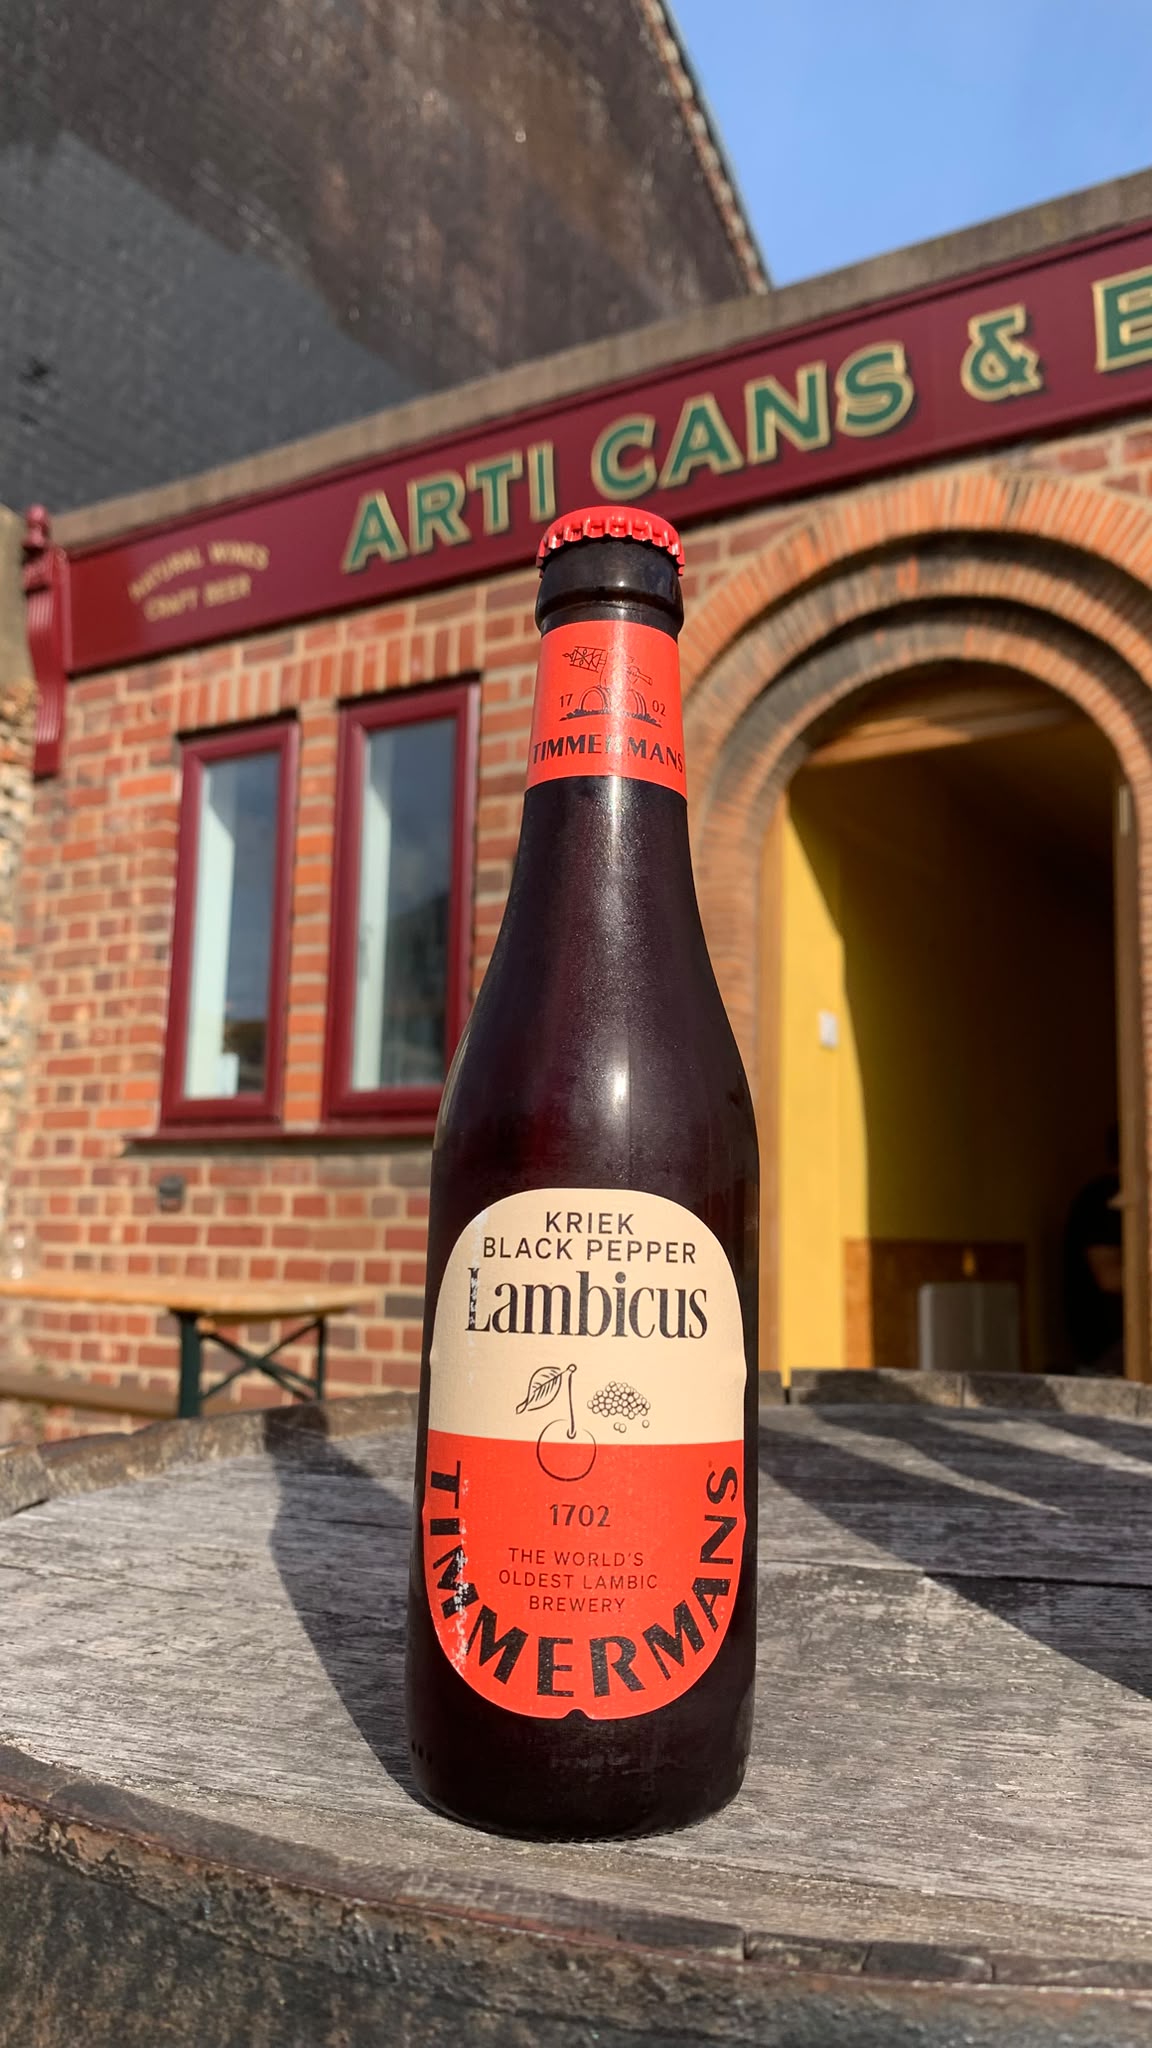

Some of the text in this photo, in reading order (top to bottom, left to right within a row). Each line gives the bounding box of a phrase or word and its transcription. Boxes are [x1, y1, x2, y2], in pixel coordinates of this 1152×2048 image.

[343, 442, 556, 572] ARTI
[590, 341, 916, 501] CANS
[961, 304, 1042, 400] &
[533, 734, 683, 773] TIMMEMANS
[545, 1211, 635, 1235] KRIEK
[483, 1237, 696, 1265] BLACK PEPPER
[465, 1267, 708, 1339] Lambicus
[549, 1504, 612, 1528] 1702
[508, 1547, 645, 1567] THE WORLD'S
[429, 1459, 739, 1698] TIMMERMANS
[498, 1569, 658, 1590] OLDEST LAMBIC
[528, 1594, 626, 1614] BREWERY
